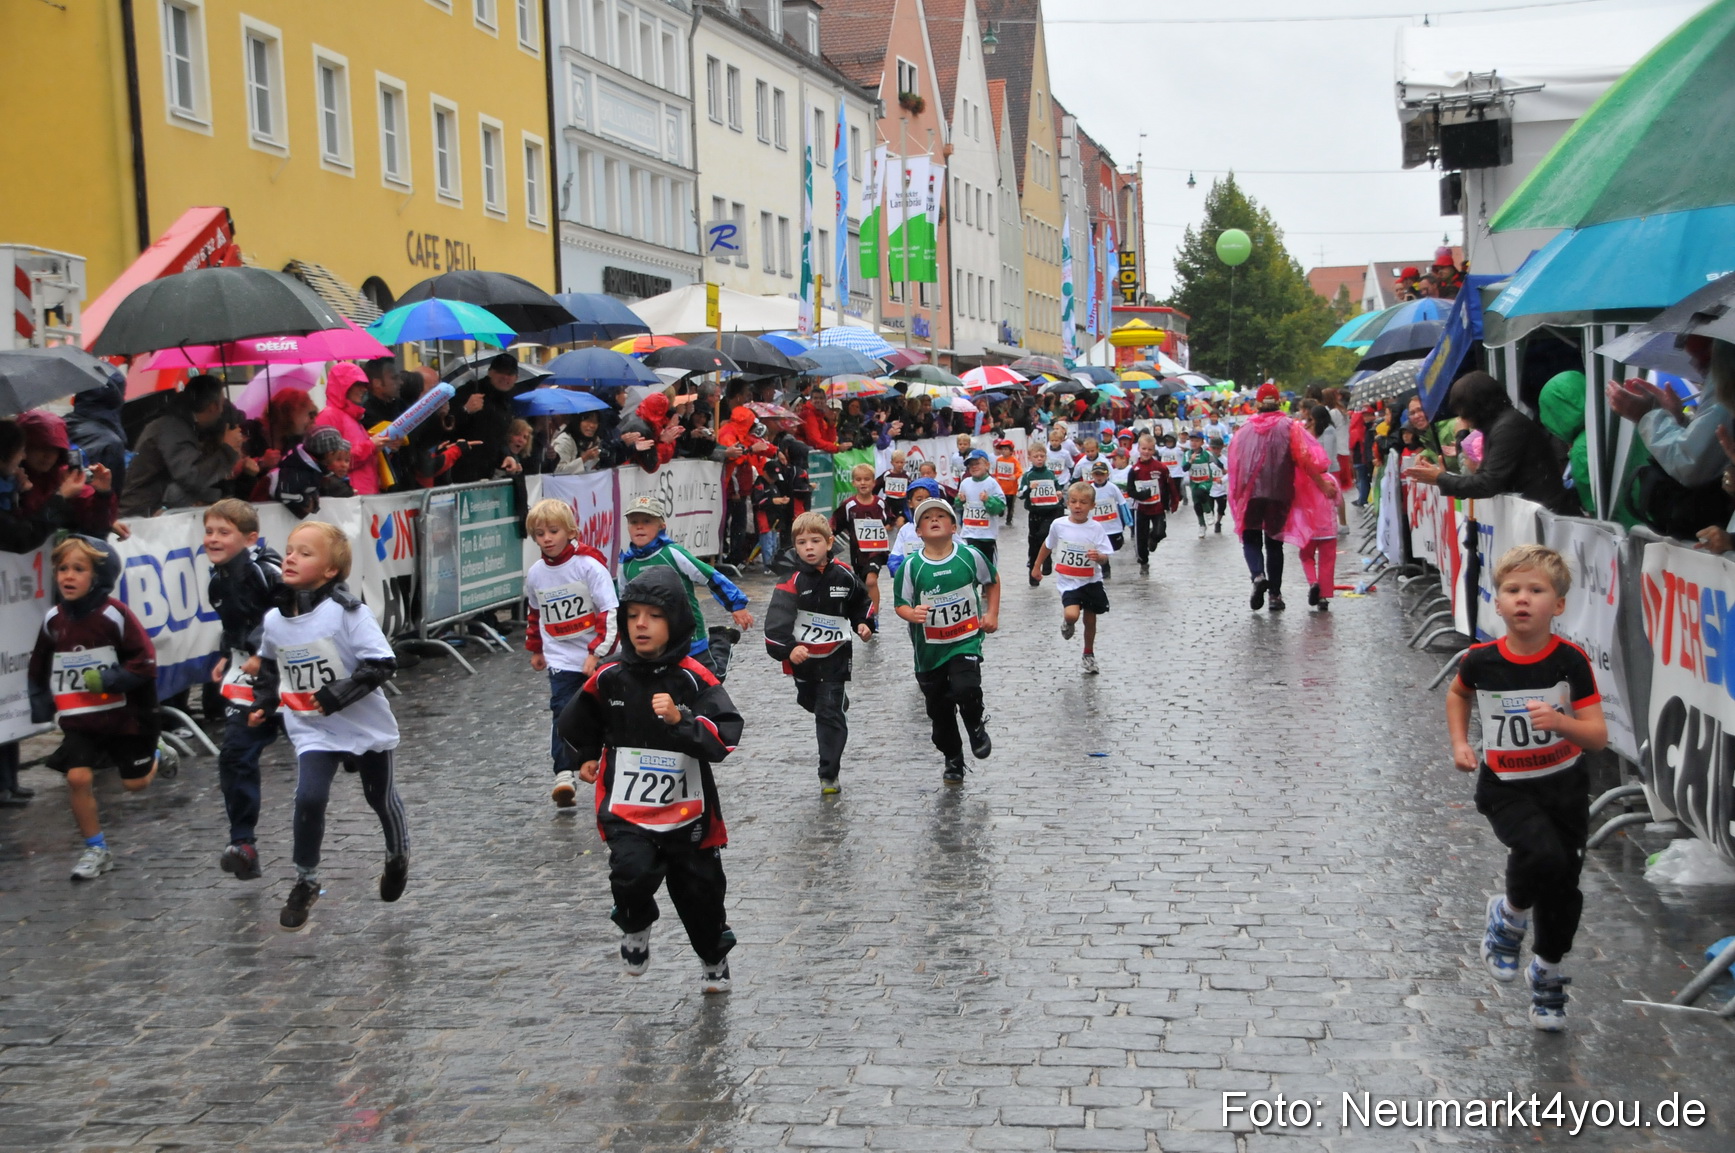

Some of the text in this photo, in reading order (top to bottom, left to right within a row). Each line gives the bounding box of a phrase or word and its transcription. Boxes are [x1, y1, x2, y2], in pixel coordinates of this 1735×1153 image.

[407, 230, 440, 270] CAFE
[1033, 486, 1055, 496] 7062
[966, 508, 987, 519] 7132
[858, 527, 886, 540] 7215
[1061, 550, 1092, 567] 7352
[541, 596, 588, 623] 7122
[928, 600, 972, 626] 7134
[939, 625, 967, 638] Lorenz
[283, 658, 337, 691] 7275
[1491, 707, 1565, 748] 705
[640, 755, 677, 768] BOCK
[623, 770, 689, 804] 7221
